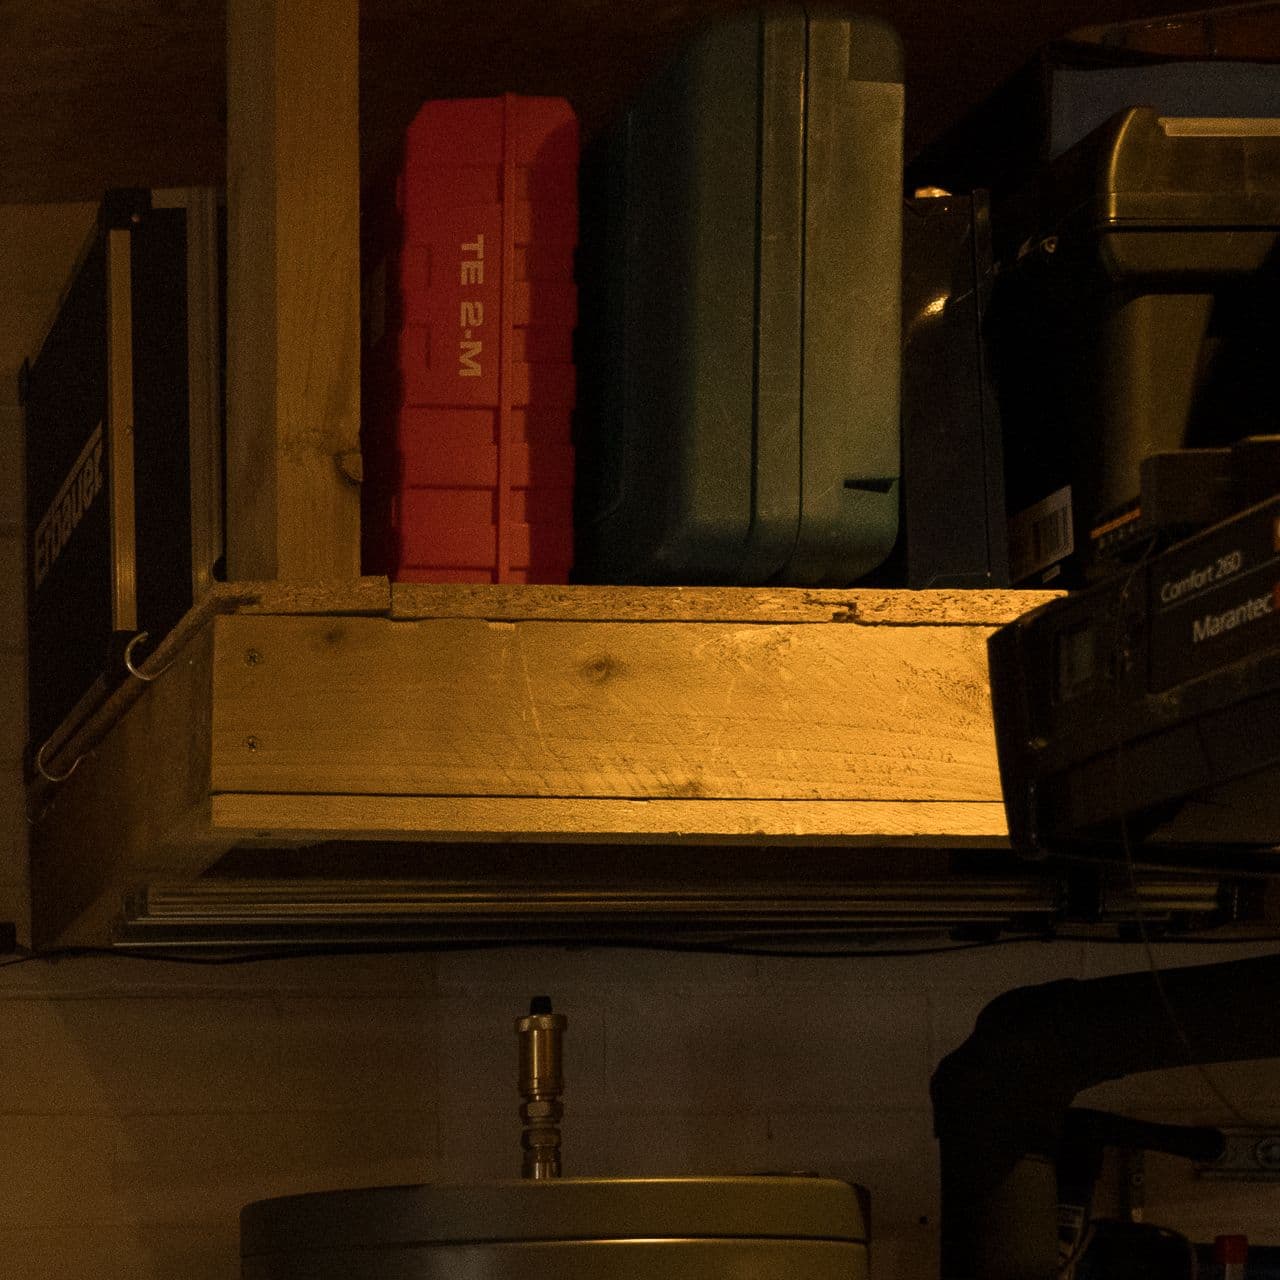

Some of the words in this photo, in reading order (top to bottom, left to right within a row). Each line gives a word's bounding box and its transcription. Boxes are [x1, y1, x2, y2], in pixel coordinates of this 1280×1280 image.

[459, 233, 485, 286] TE
[458, 301, 485, 377] 2-M
[1160, 564, 1215, 603] Comfort
[1192, 592, 1274, 644] Marantec
